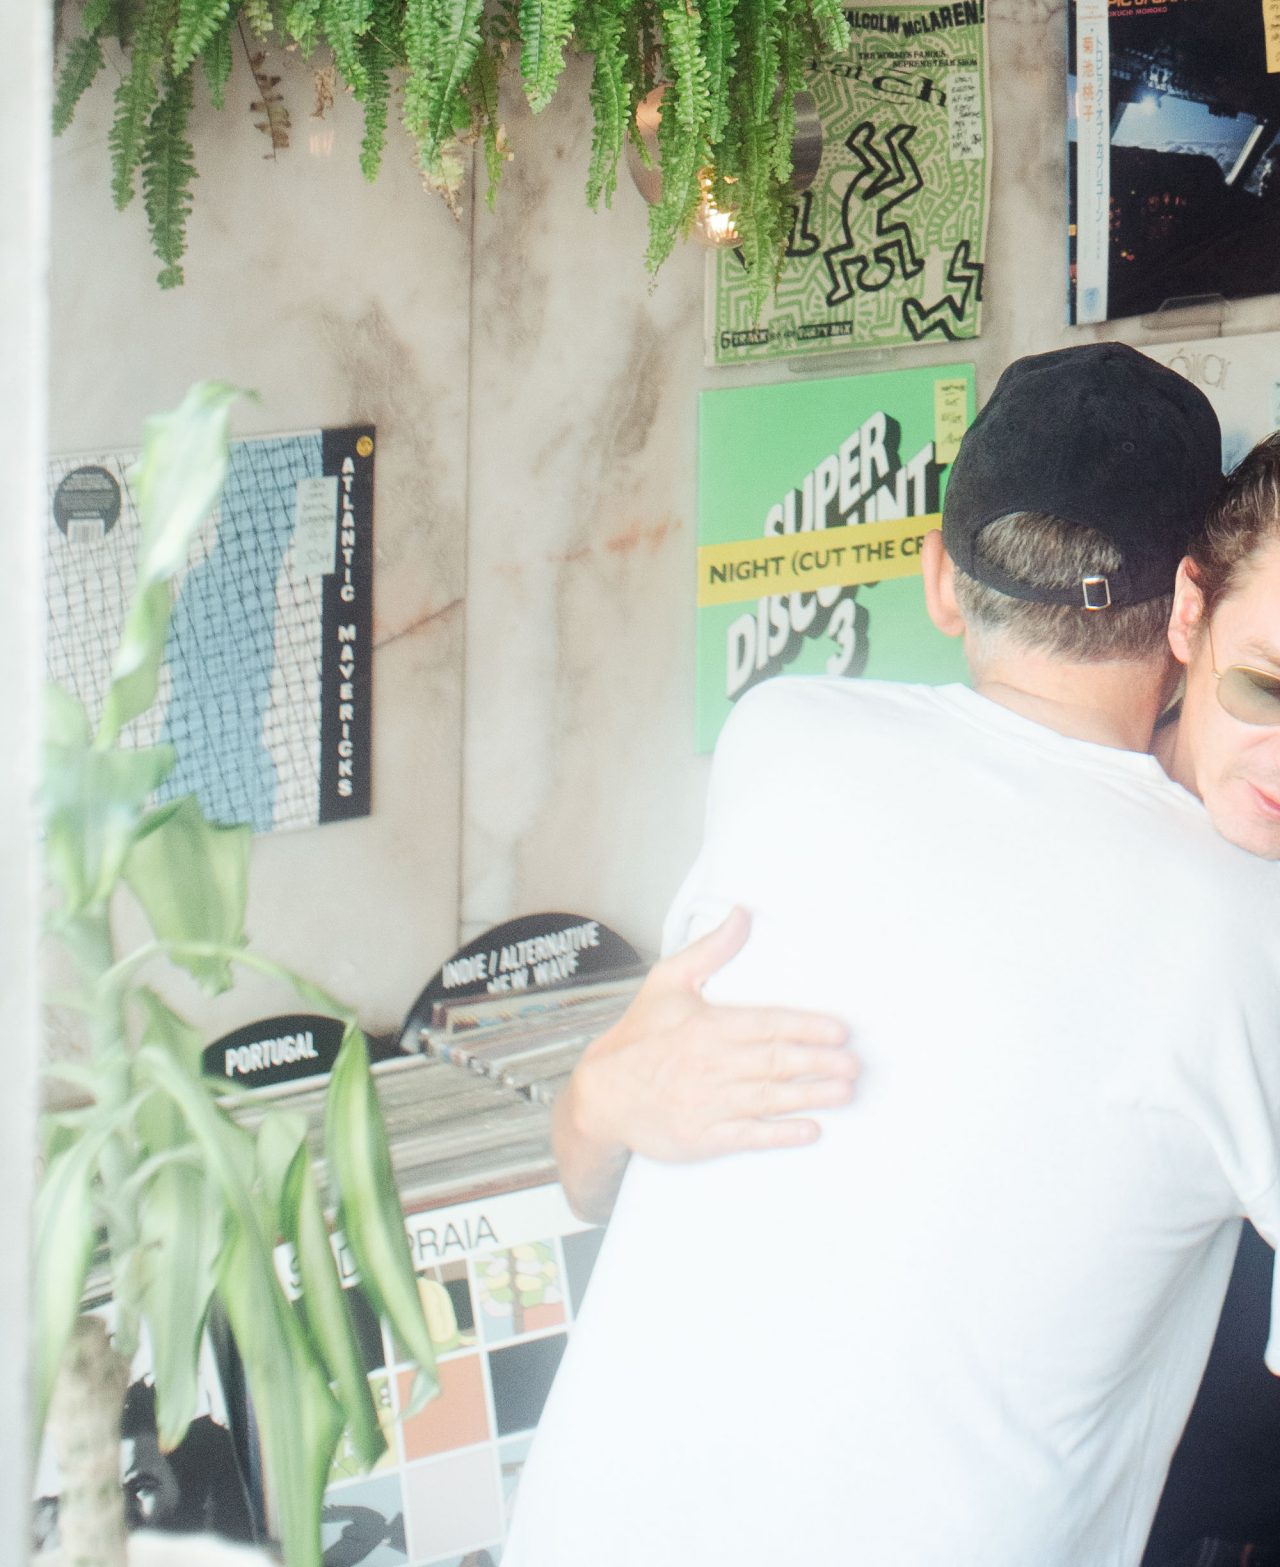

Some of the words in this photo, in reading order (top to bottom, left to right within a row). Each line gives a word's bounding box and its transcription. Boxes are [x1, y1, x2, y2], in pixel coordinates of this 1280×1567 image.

[844, 10, 899, 33] ALCOLM
[859, 51, 875, 60] THE
[914, 50, 946, 59] FAMOUS
[893, 60, 932, 68] SUPREME
[340, 456, 356, 602] ATLANTIC
[709, 556, 785, 584] NIGHT
[792, 547, 847, 576] (CUT
[852, 540, 896, 563] THE
[825, 598, 857, 677] 3
[337, 624, 357, 798] MAVERICKS
[442, 952, 488, 989] INDIE
[500, 920, 600, 973] ALTERNATIVE
[487, 967, 529, 994] NEW
[533, 950, 580, 986] WAVE
[225, 1031, 319, 1077] PORTUGAL
[408, 1215, 499, 1261] RAIA
